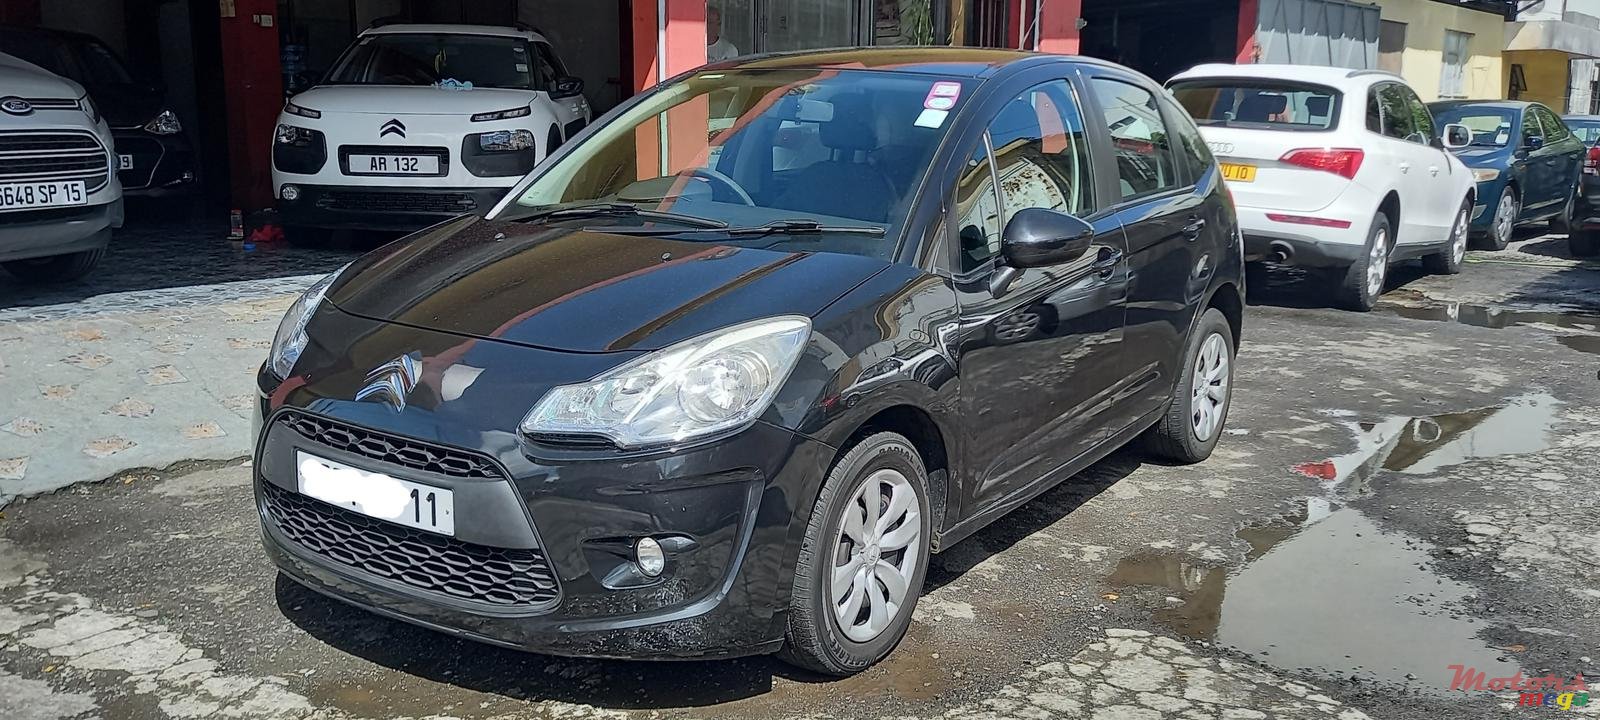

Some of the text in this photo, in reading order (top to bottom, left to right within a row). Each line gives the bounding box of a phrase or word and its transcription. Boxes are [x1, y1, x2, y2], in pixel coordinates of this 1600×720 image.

[10, 102, 26, 110] Ford
[370, 156, 418, 172] AR 132
[38, 184, 57, 203] SP
[63, 184, 81, 202] 15
[410, 488, 437, 527] 11
